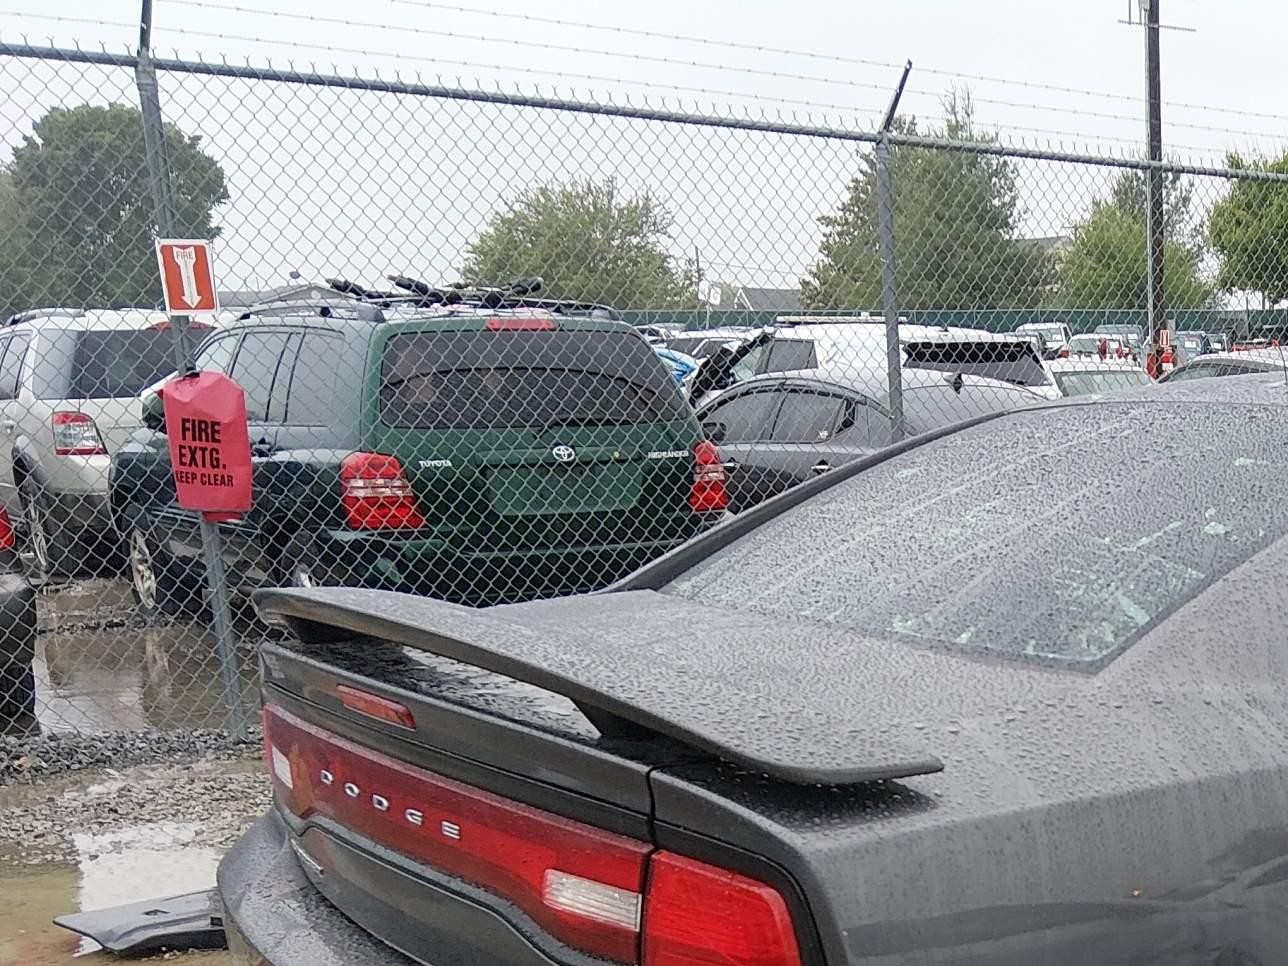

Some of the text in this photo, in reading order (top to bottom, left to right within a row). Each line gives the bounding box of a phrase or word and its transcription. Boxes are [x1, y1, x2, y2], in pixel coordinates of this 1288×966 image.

[176, 250, 194, 260] FIRE
[181, 418, 222, 444] FIRE
[178, 444, 227, 471] EXTG.
[200, 472, 234, 488] CLEAR
[320, 769, 462, 840] DODGE
